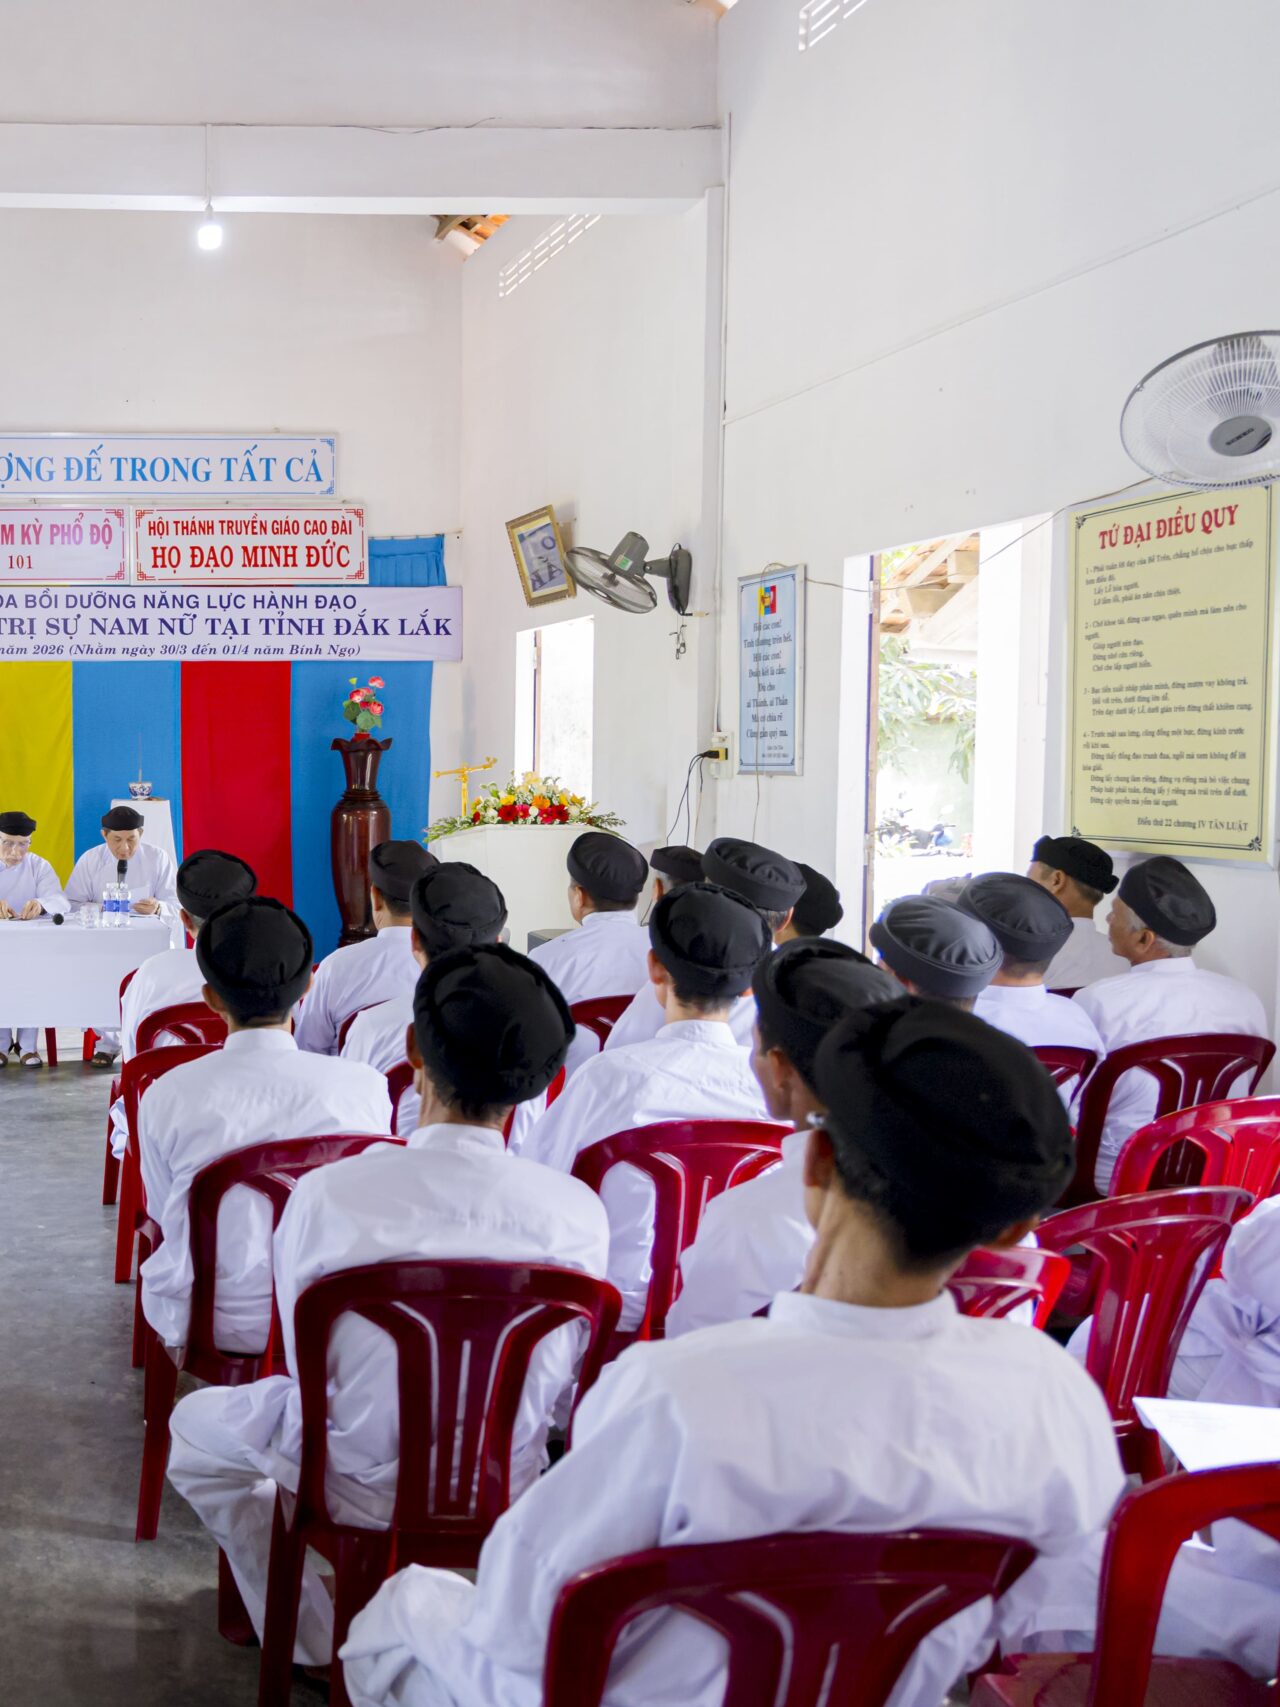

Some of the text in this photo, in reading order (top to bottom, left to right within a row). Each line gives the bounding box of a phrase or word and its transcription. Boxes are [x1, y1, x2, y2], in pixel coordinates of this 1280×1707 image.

[64, 444, 104, 482] ĐẾ
[111, 457, 212, 482] TRONG
[221, 444, 277, 482] TẤT
[286, 449, 323, 482] CẢ
[21, 518, 43, 546] KỲ
[49, 512, 84, 546] PHỔ
[90, 515, 114, 550] ĐỘ
[147, 513, 353, 540] HỘI THÁNH TRUYỀN GIÁO CAO ĐÀI
[1099, 504, 1239, 550] TỨ ĐẠI ĐIỀU QUY
[8, 555, 33, 570] 101
[151, 538, 350, 574] HỌ ĐẠO MINH ĐỨC
[25, 587, 57, 608] BỒI
[66, 591, 136, 609] DƯỠNG
[144, 590, 200, 609] NĂNG
[208, 593, 246, 612] LỰC
[254, 590, 308, 609] HÀNH
[315, 594, 356, 611] ĐẠO
[46, 614, 81, 639] SỰ
[90, 618, 148, 635] NAM
[158, 614, 197, 635] NỮ
[205, 618, 251, 639] TẠI
[259, 610, 326, 635] TỈNH
[334, 610, 390, 636] ĐẮK
[399, 610, 453, 636] LẮK
[32, 645, 64, 654] 2026
[69, 643, 116, 654] (Nhằm
[122, 645, 155, 657] ngày
[160, 644, 187, 654] 30/3
[192, 643, 216, 654] đến
[222, 645, 248, 654] 01/4
[254, 646, 284, 654] năm
[289, 644, 322, 654] Bính
[328, 644, 360, 657] Ngọ)
